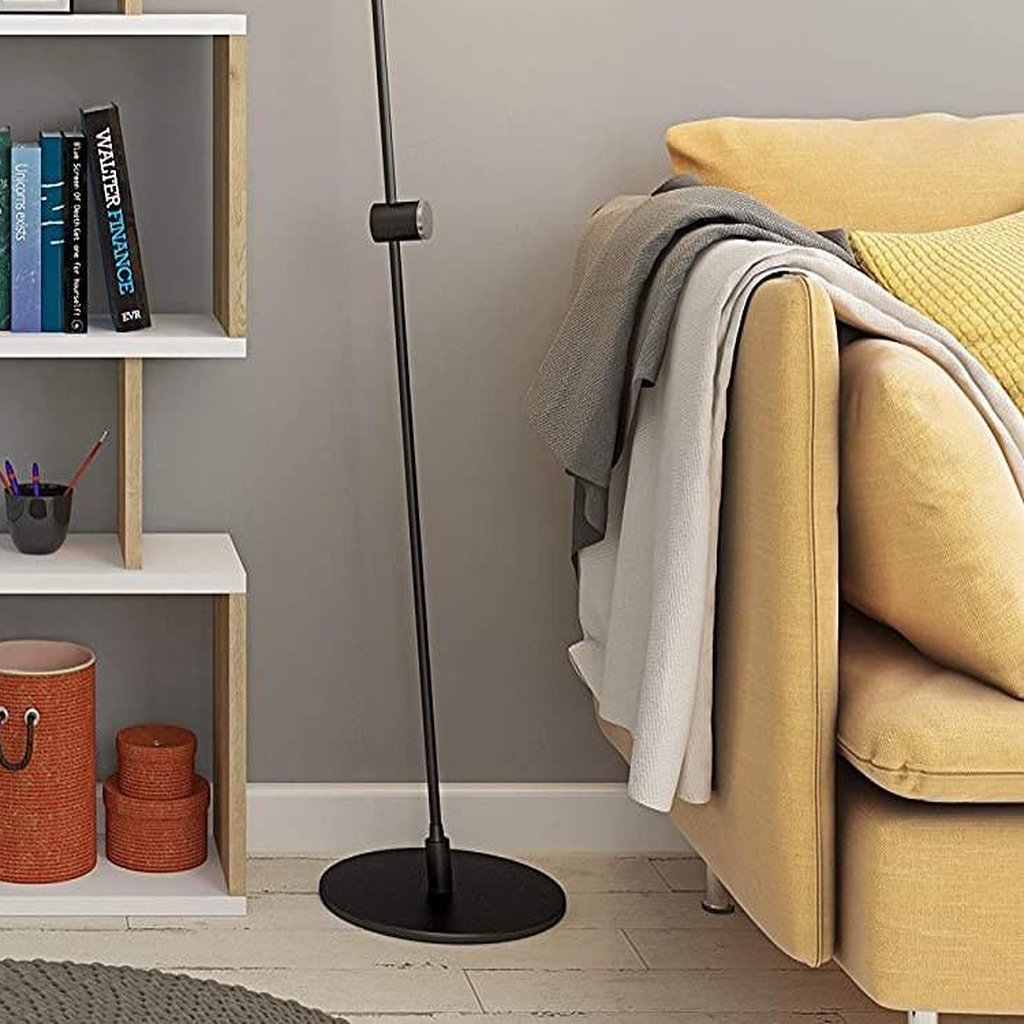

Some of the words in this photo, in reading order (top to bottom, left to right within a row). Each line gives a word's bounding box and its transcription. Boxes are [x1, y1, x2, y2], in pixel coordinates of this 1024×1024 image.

[14, 163, 28, 210] Unicorns
[72, 163, 81, 189] Screen
[94, 126, 121, 209] WALTER
[108, 208, 135, 295] FINANCE
[14, 211, 27, 241] exists
[121, 309, 142, 323] EVR
